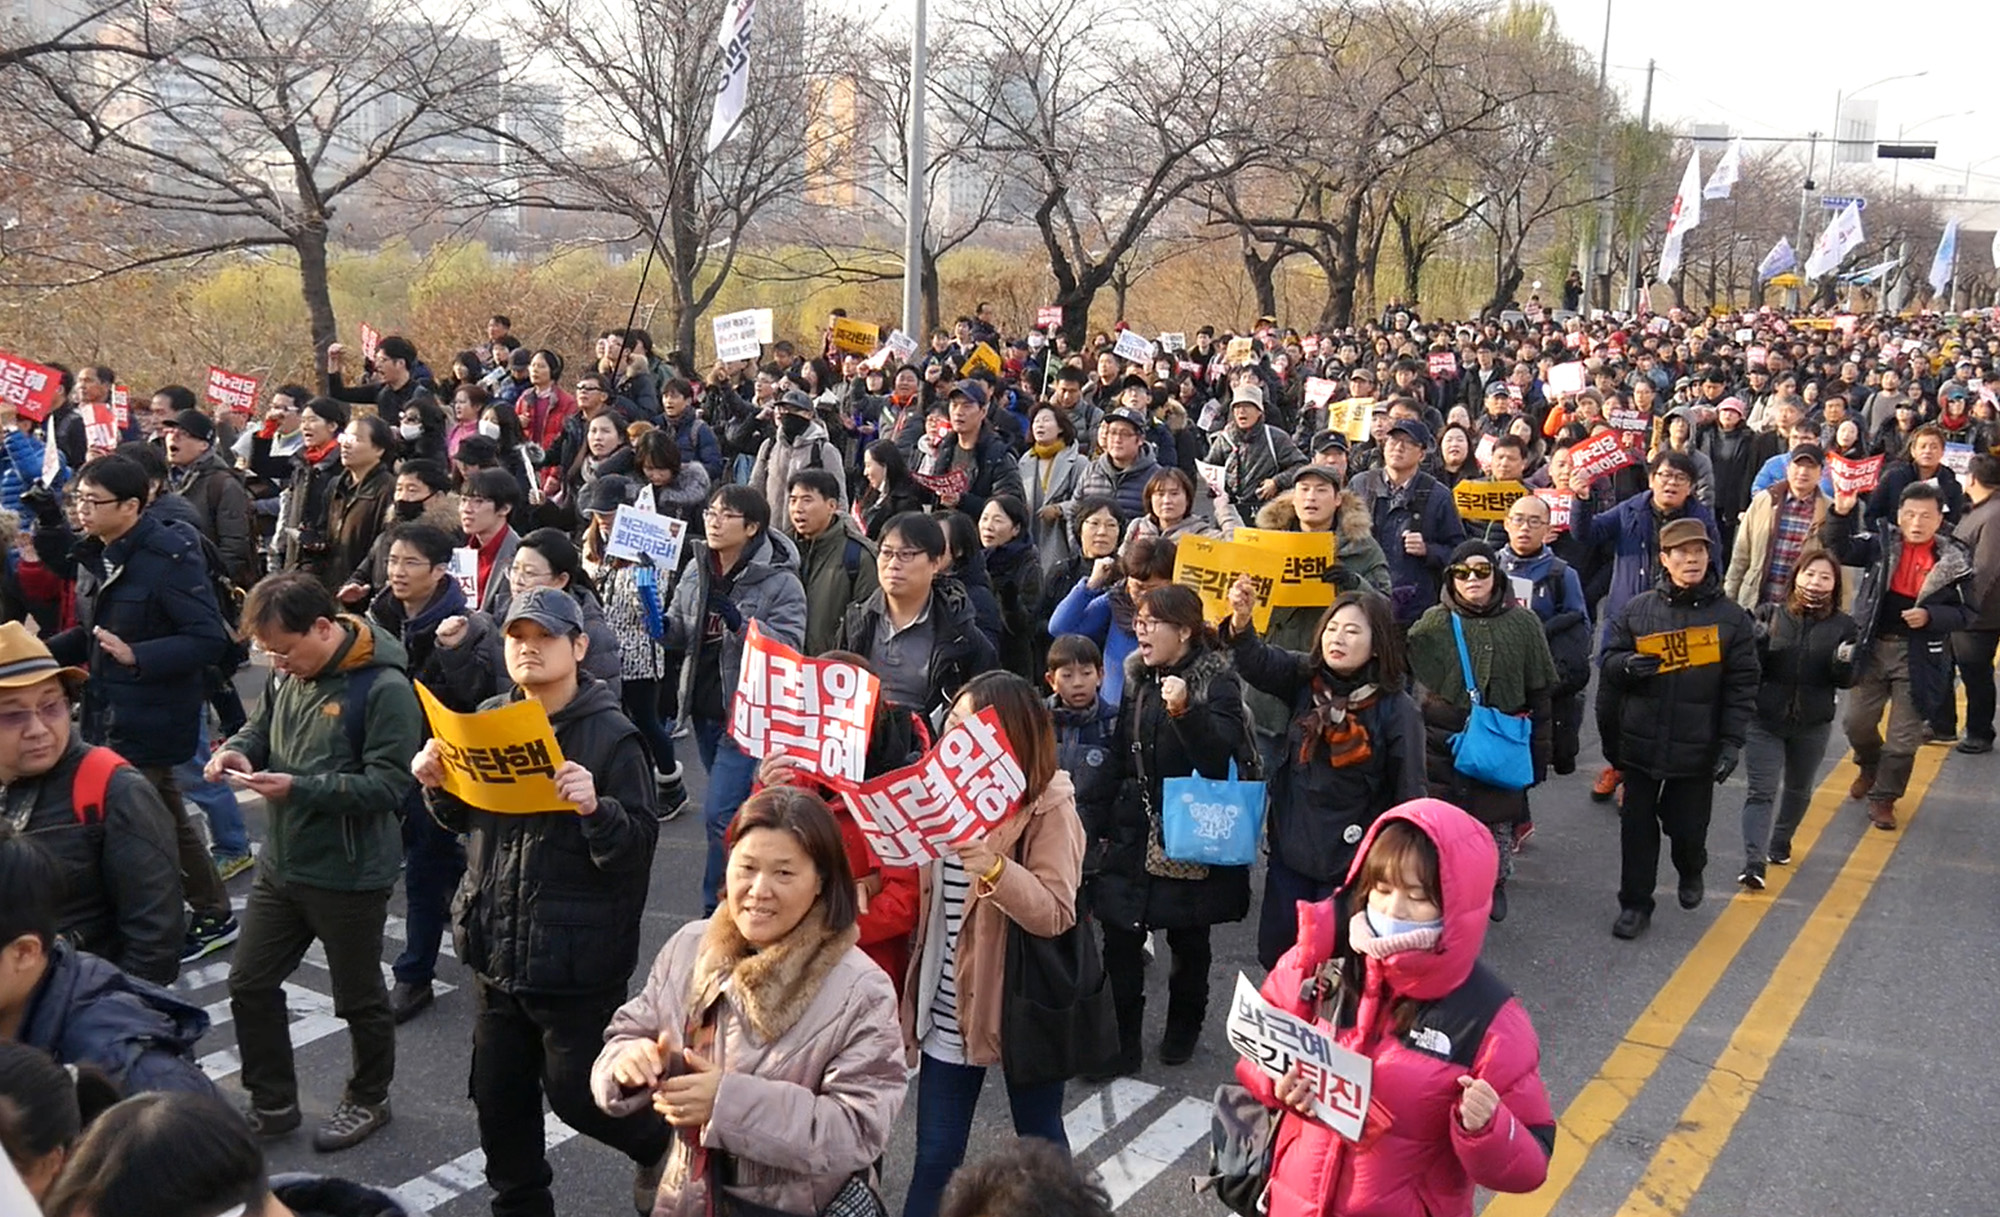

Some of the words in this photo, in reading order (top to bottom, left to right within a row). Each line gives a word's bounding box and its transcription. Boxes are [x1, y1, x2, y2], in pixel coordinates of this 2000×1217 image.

[211, 370, 256, 396] 새누리당
[1572, 434, 1617, 467] 새누리당
[615, 529, 677, 559] 퇴진하라!
[737, 640, 871, 728] 내려와
[733, 694, 867, 783] 박근혜
[841, 714, 1004, 835] 내려와
[864, 751, 1027, 867] 박근혜
[1238, 994, 1333, 1067] 박근혜
